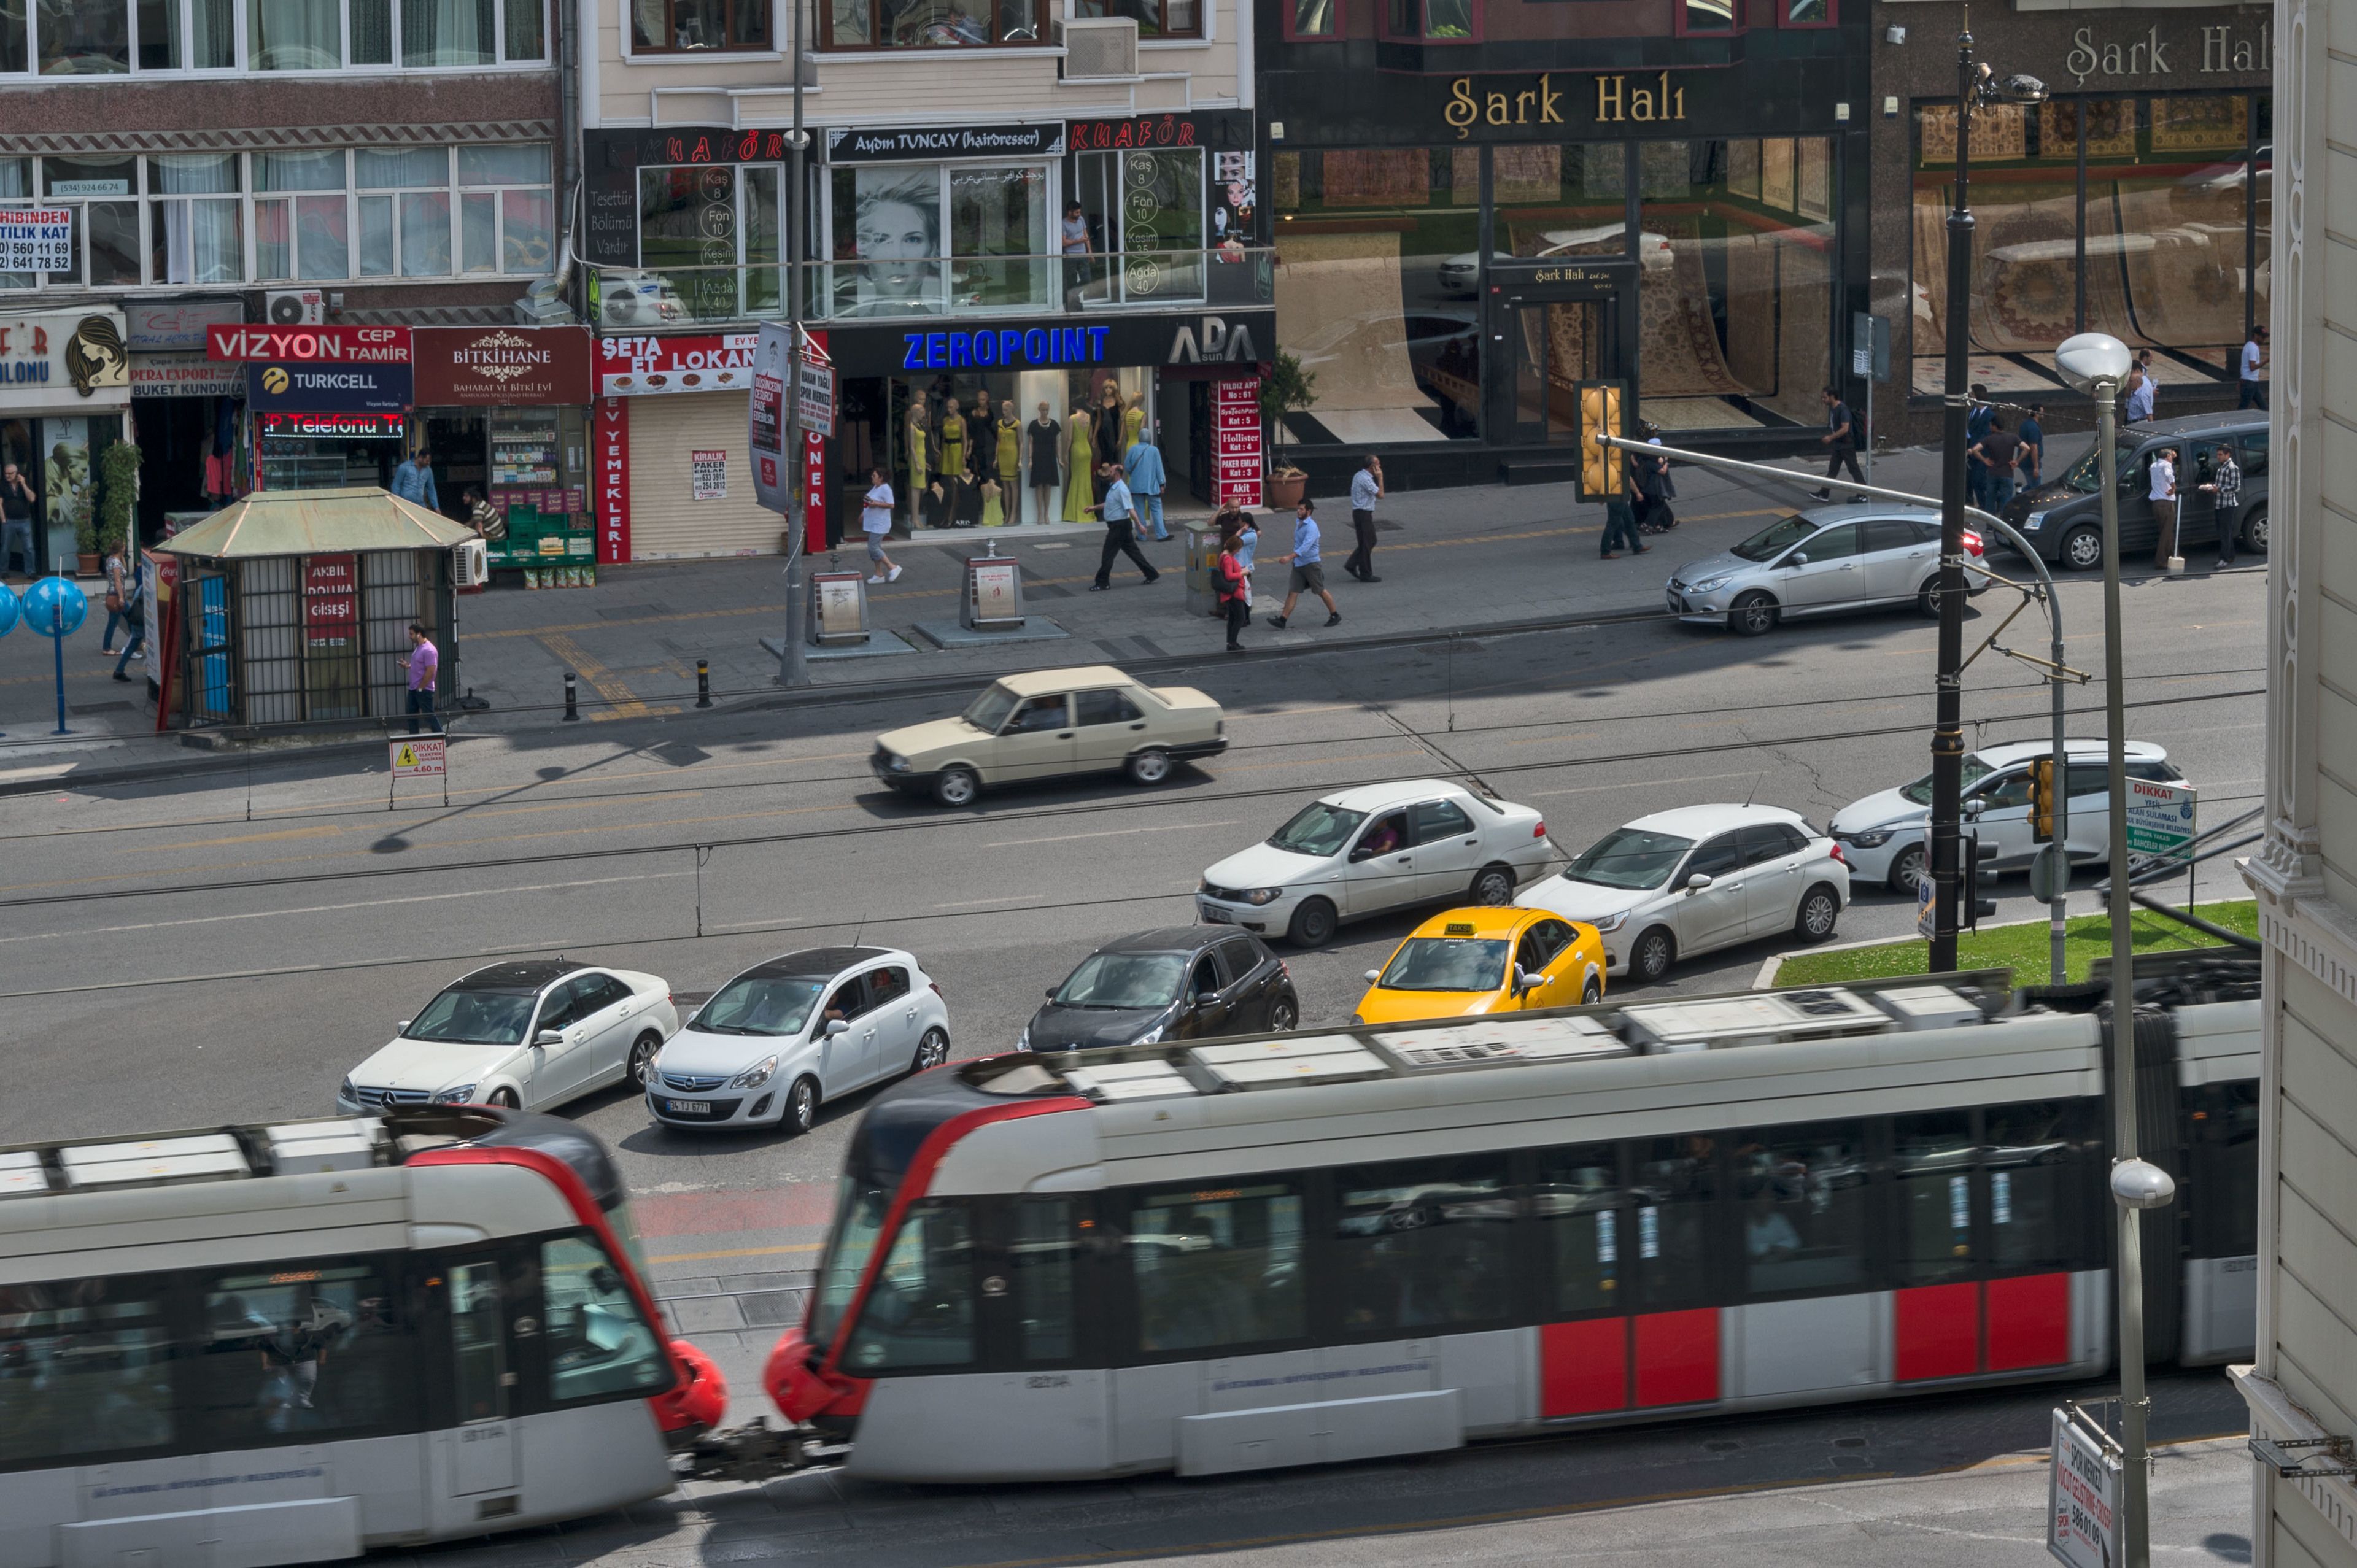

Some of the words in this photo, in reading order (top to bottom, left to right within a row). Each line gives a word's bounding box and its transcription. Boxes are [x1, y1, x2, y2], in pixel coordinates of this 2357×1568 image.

[2066, 25, 2172, 87] Şark
[1444, 73, 1563, 139] Şark
[1595, 71, 1686, 122] Halı
[1071, 115, 1194, 150] KUAFÖR
[643, 130, 783, 163] KUAFÖR
[855, 135, 896, 153] Aydın
[898, 133, 961, 149] TUNCAY
[963, 129, 1040, 149] (hairdresser)
[1130, 160, 1151, 172] Kaş
[706, 172, 728, 185] Kaş
[1139, 174, 1145, 184] 8
[61, 184, 80, 193] (534)
[714, 188, 721, 198] 8
[590, 190, 633, 206] Tesettür
[1133, 196, 1153, 207] Fön
[708, 210, 729, 222] Fön
[1136, 210, 1147, 220] 10
[591, 215, 632, 231] Bölümü
[712, 223, 724, 234] 10
[41, 227, 69, 239] KAT
[1128, 233, 1157, 243] Kesim
[13, 242, 34, 255] 560
[37, 243, 50, 254] 11
[55, 242, 68, 254] 69
[596, 239, 629, 255] Vardır
[704, 247, 734, 259] Kesim
[13, 257, 33, 269] 641
[37, 257, 51, 269] 78
[54, 257, 68, 268] 52
[1129, 266, 1156, 280] Ağda
[1536, 268, 1561, 283] Şark
[1565, 268, 1584, 280] Halı
[705, 282, 734, 295] Ağda
[1137, 280, 1148, 292] 40
[714, 297, 726, 307] 40
[357, 330, 396, 342] CEP
[735, 336, 746, 346] EV
[215, 330, 340, 357] VİZYON
[602, 337, 663, 361] ŞETA
[904, 326, 1109, 368] ZEROPOINT
[346, 345, 408, 360] TAMİR
[454, 348, 551, 363] BİTKİHANE
[1201, 352, 1223, 361] sun
[632, 355, 657, 373] ET
[130, 369, 164, 382] PERA
[167, 368, 217, 380] EXPORT
[295, 374, 377, 389] TURKCELL
[454, 384, 494, 392] BAHARAT
[510, 382, 534, 392] BİTKİ
[537, 382, 552, 392] EVİ
[1222, 382, 1243, 390] YILDIZ
[133, 384, 177, 396] BUKET
[180, 382, 246, 395] KUNDURA
[800, 386, 811, 401] SPOR
[288, 413, 376, 433] Telefonu
[1223, 434, 1259, 443] Hollister
[694, 452, 725, 462] KİRALIK
[694, 461, 725, 469] PAKER
[1222, 460, 1240, 468] PAKER
[702, 473, 712, 482] 633
[713, 473, 726, 481] 3914
[1233, 483, 1250, 493] Akit
[606, 431, 622, 560] YEMEKLERİ
[413, 742, 443, 752] DİKKAT
[2134, 782, 2173, 800] DİKKAT
[2145, 799, 2161, 809] YEŞİL
[2146, 809, 2177, 822] SULAMASI
[2166, 824, 2192, 835] BELEDİYESİ
[681, 1102, 689, 1110] TJ
[692, 1103, 709, 1111] 6771
[2071, 1443, 2083, 1476] SPOR
[2072, 1504, 2083, 1531] 586
[2084, 1515, 2091, 1538] 01
[2092, 1523, 2100, 1545] 09
